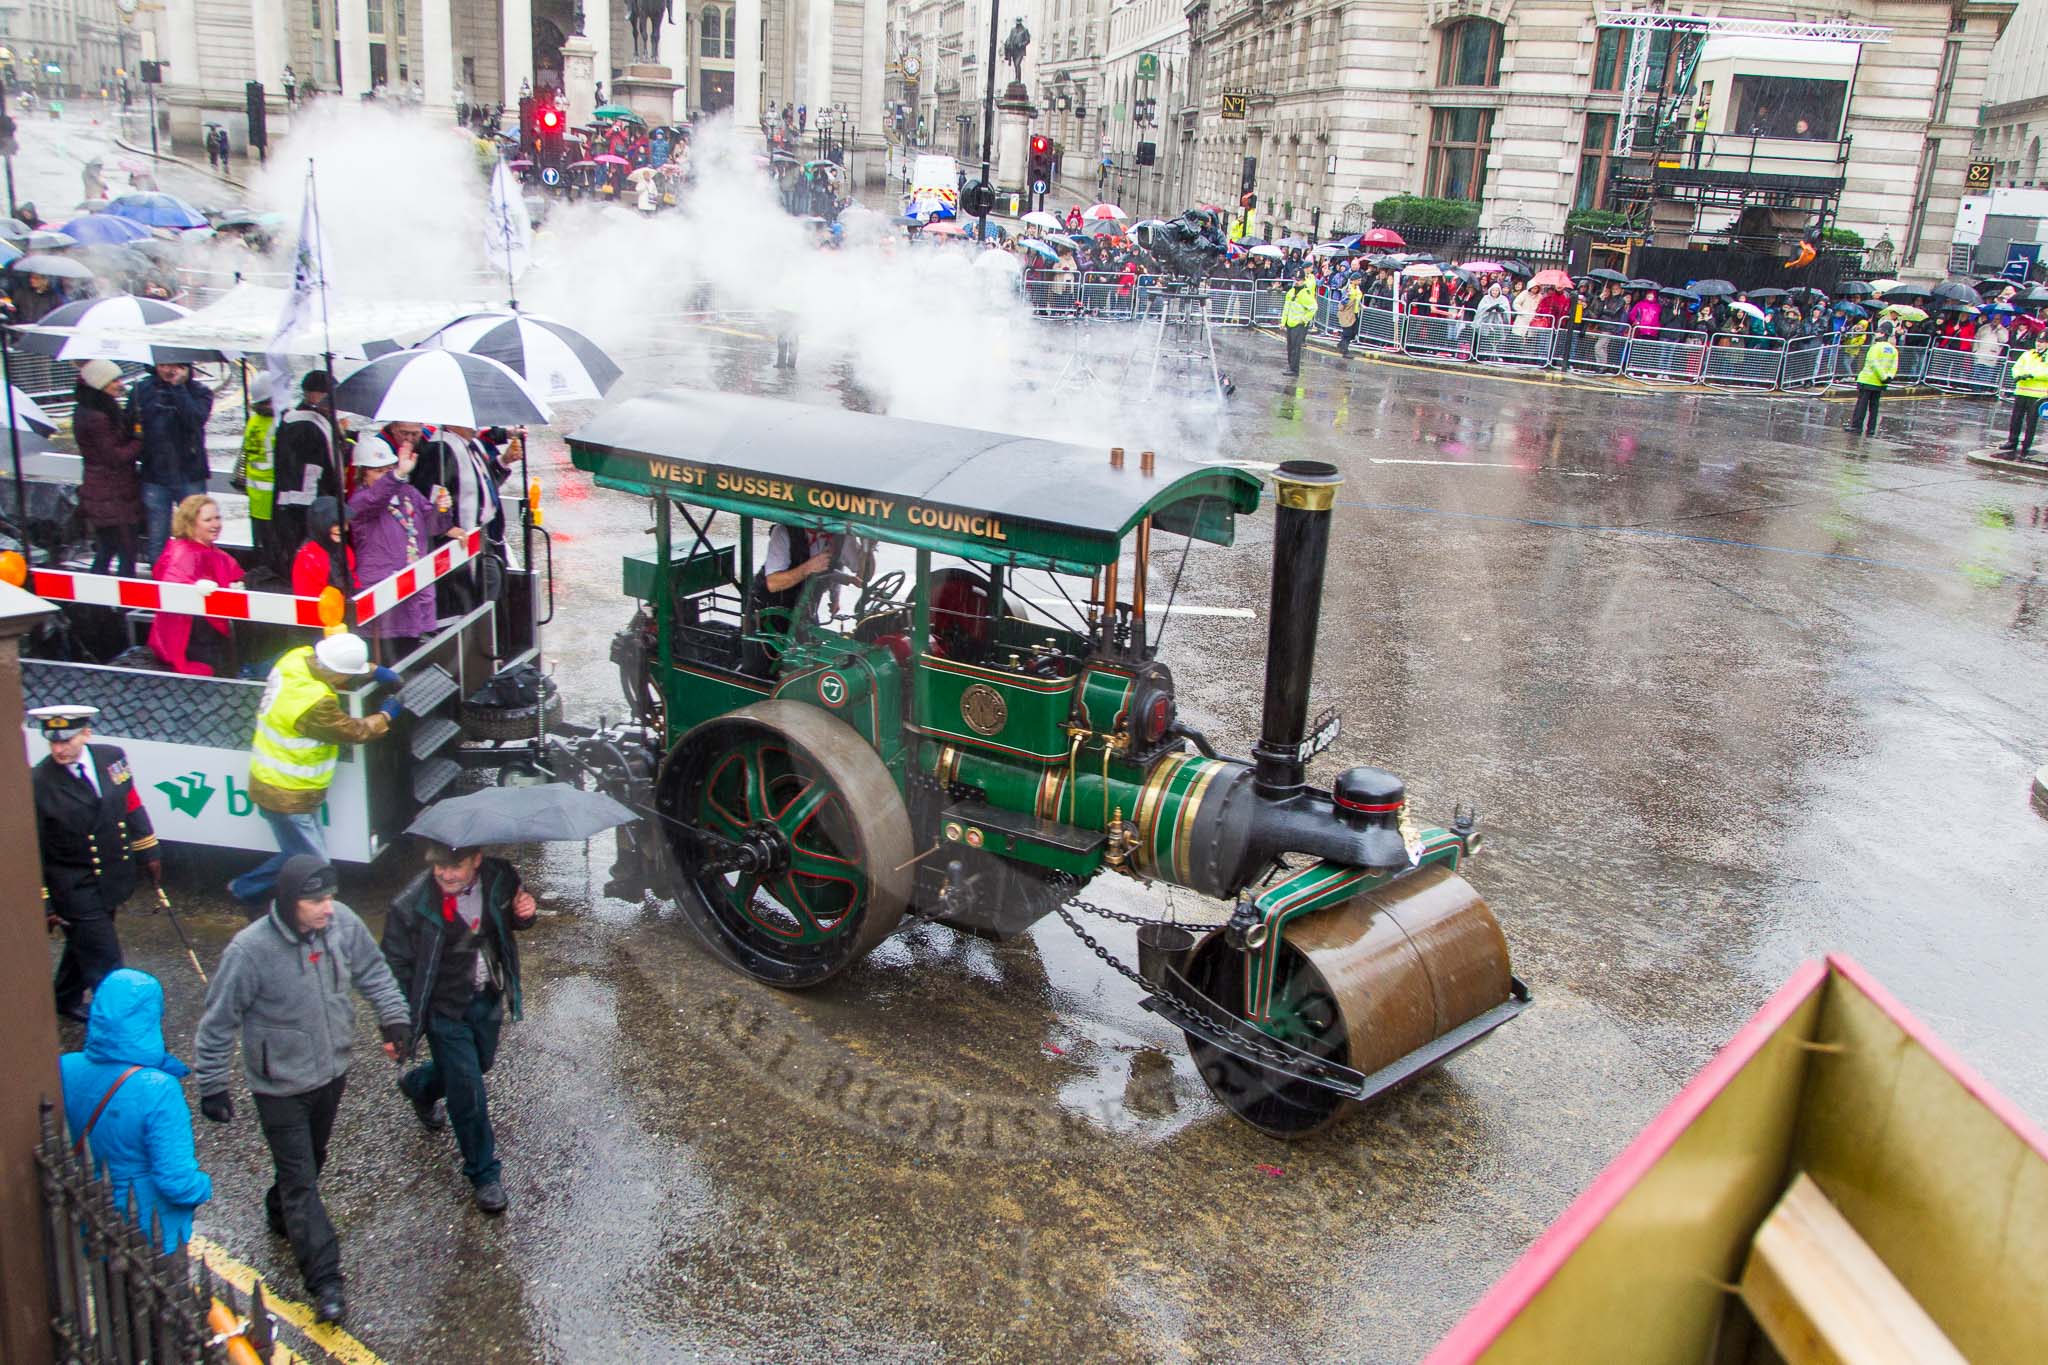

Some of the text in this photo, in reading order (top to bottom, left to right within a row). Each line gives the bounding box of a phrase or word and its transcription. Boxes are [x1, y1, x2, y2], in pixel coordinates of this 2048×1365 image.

[1969, 165, 1990, 181] 82
[648, 459, 1007, 541] WEST SUSSEX COUNTY COUNCIL
